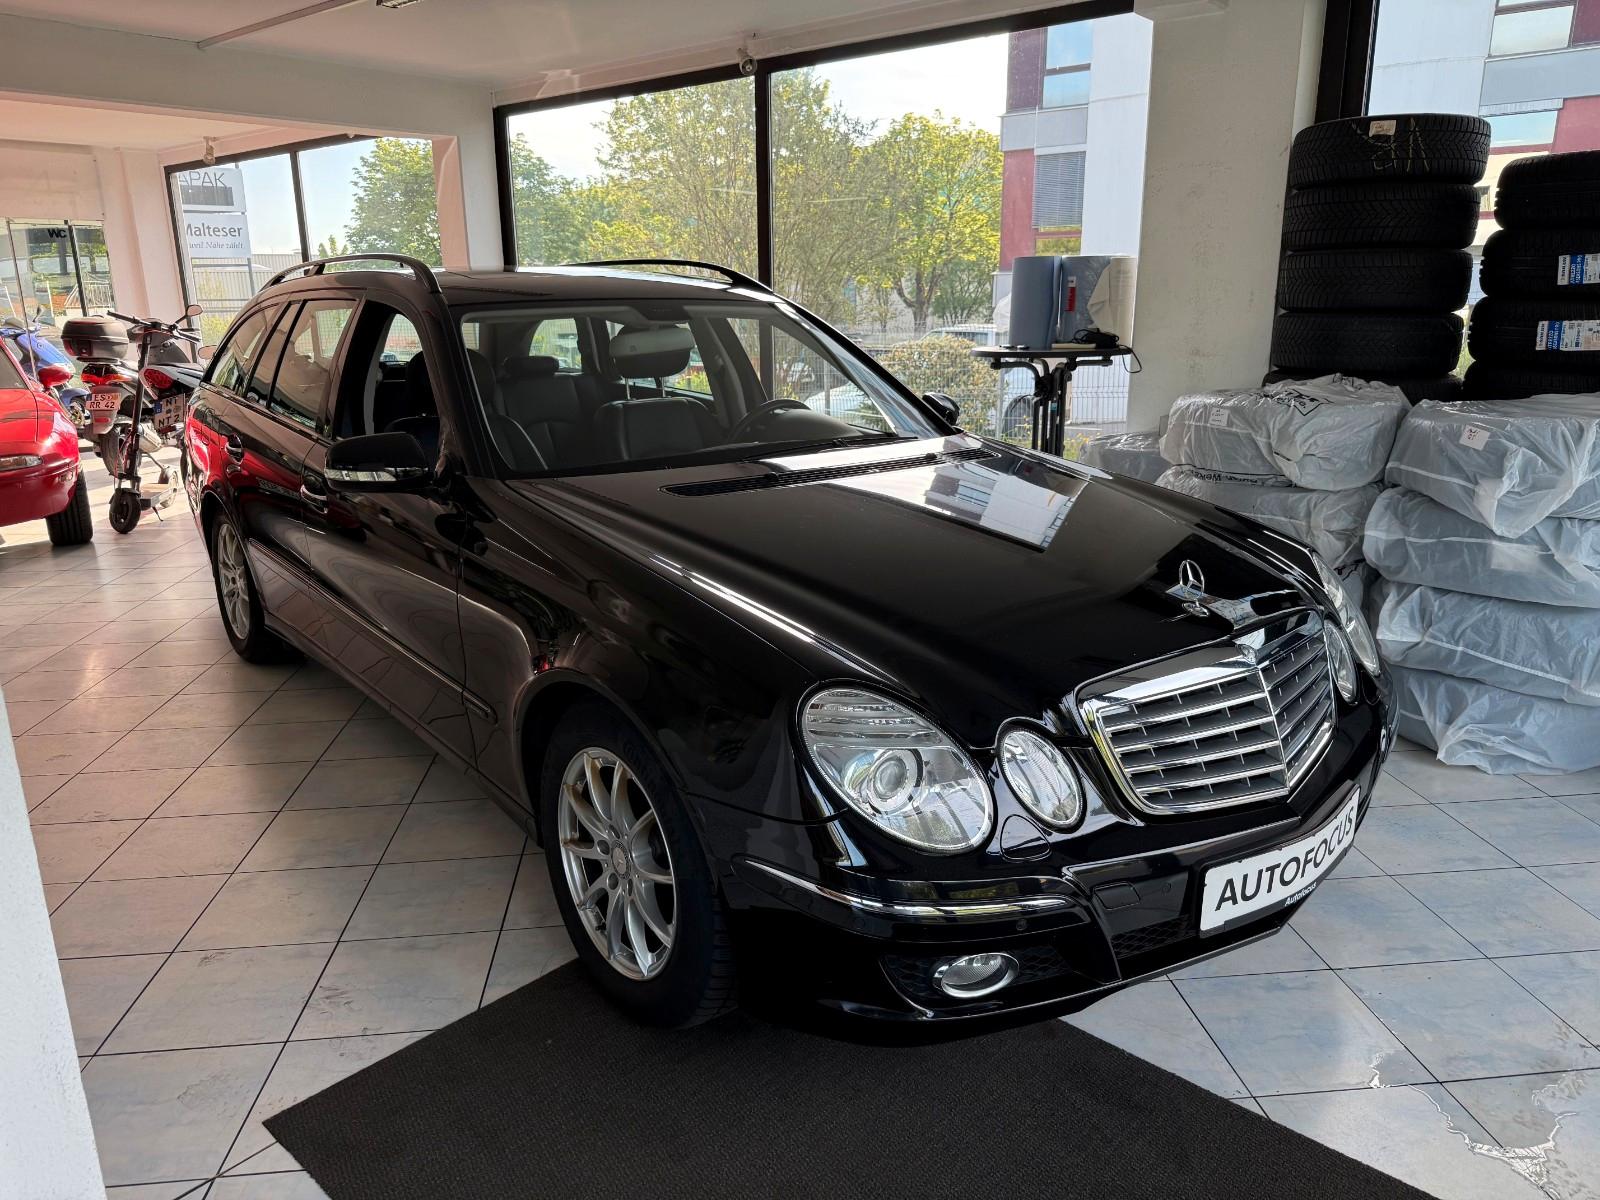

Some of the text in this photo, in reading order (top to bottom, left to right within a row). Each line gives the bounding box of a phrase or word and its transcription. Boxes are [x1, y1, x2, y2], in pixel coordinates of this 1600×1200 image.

[48, 228, 67, 238] WC
[104, 401, 115, 409] 42
[1215, 806, 1354, 911] AUTOFOCUS
